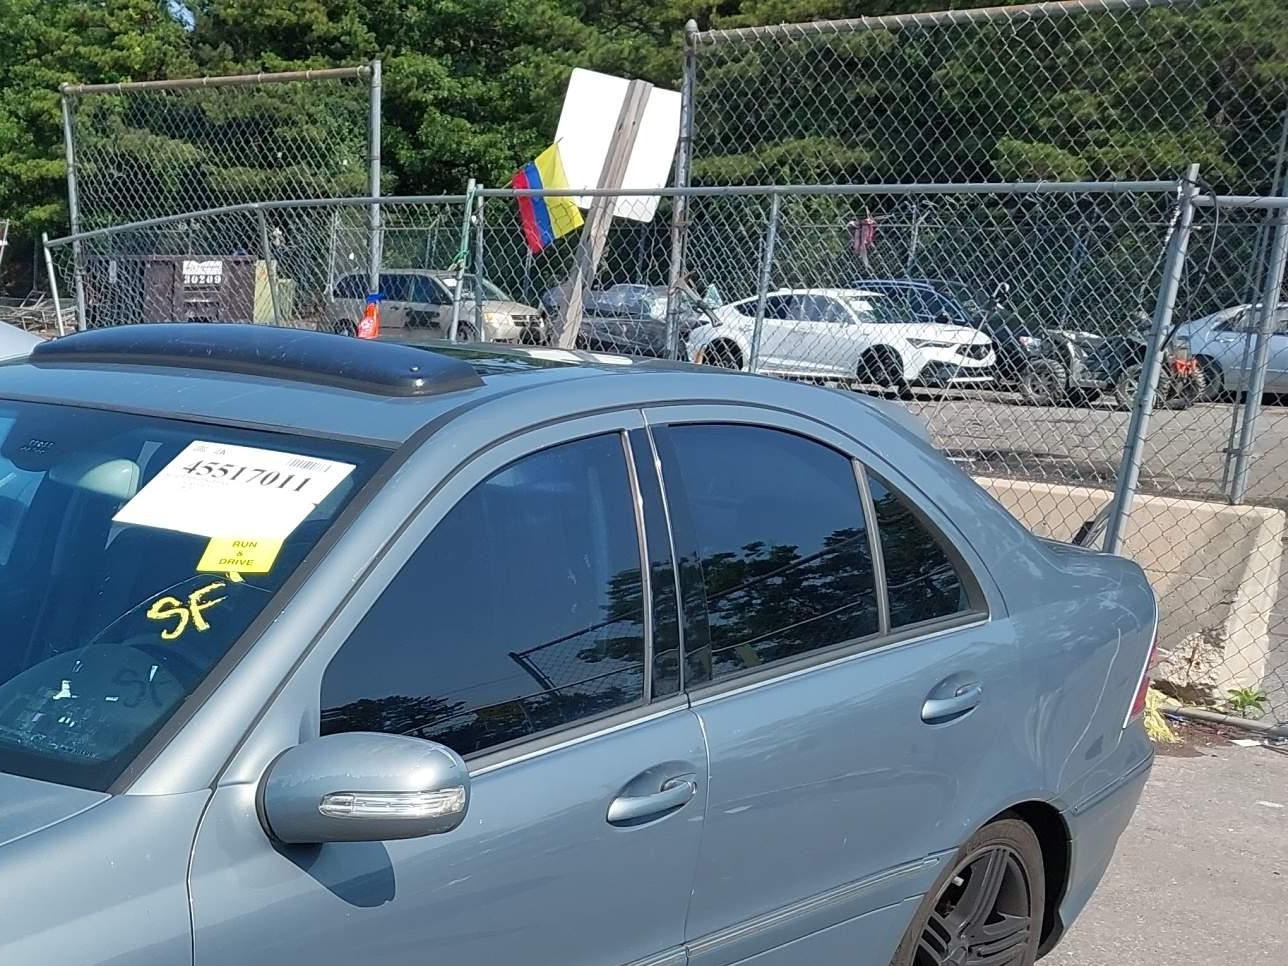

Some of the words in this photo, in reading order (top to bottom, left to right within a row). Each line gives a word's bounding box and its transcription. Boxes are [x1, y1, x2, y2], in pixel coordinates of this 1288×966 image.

[183, 459, 312, 492] 45517011
[232, 540, 258, 549] RUN
[218, 558, 255, 567] DRIVE
[146, 581, 228, 639] SF
